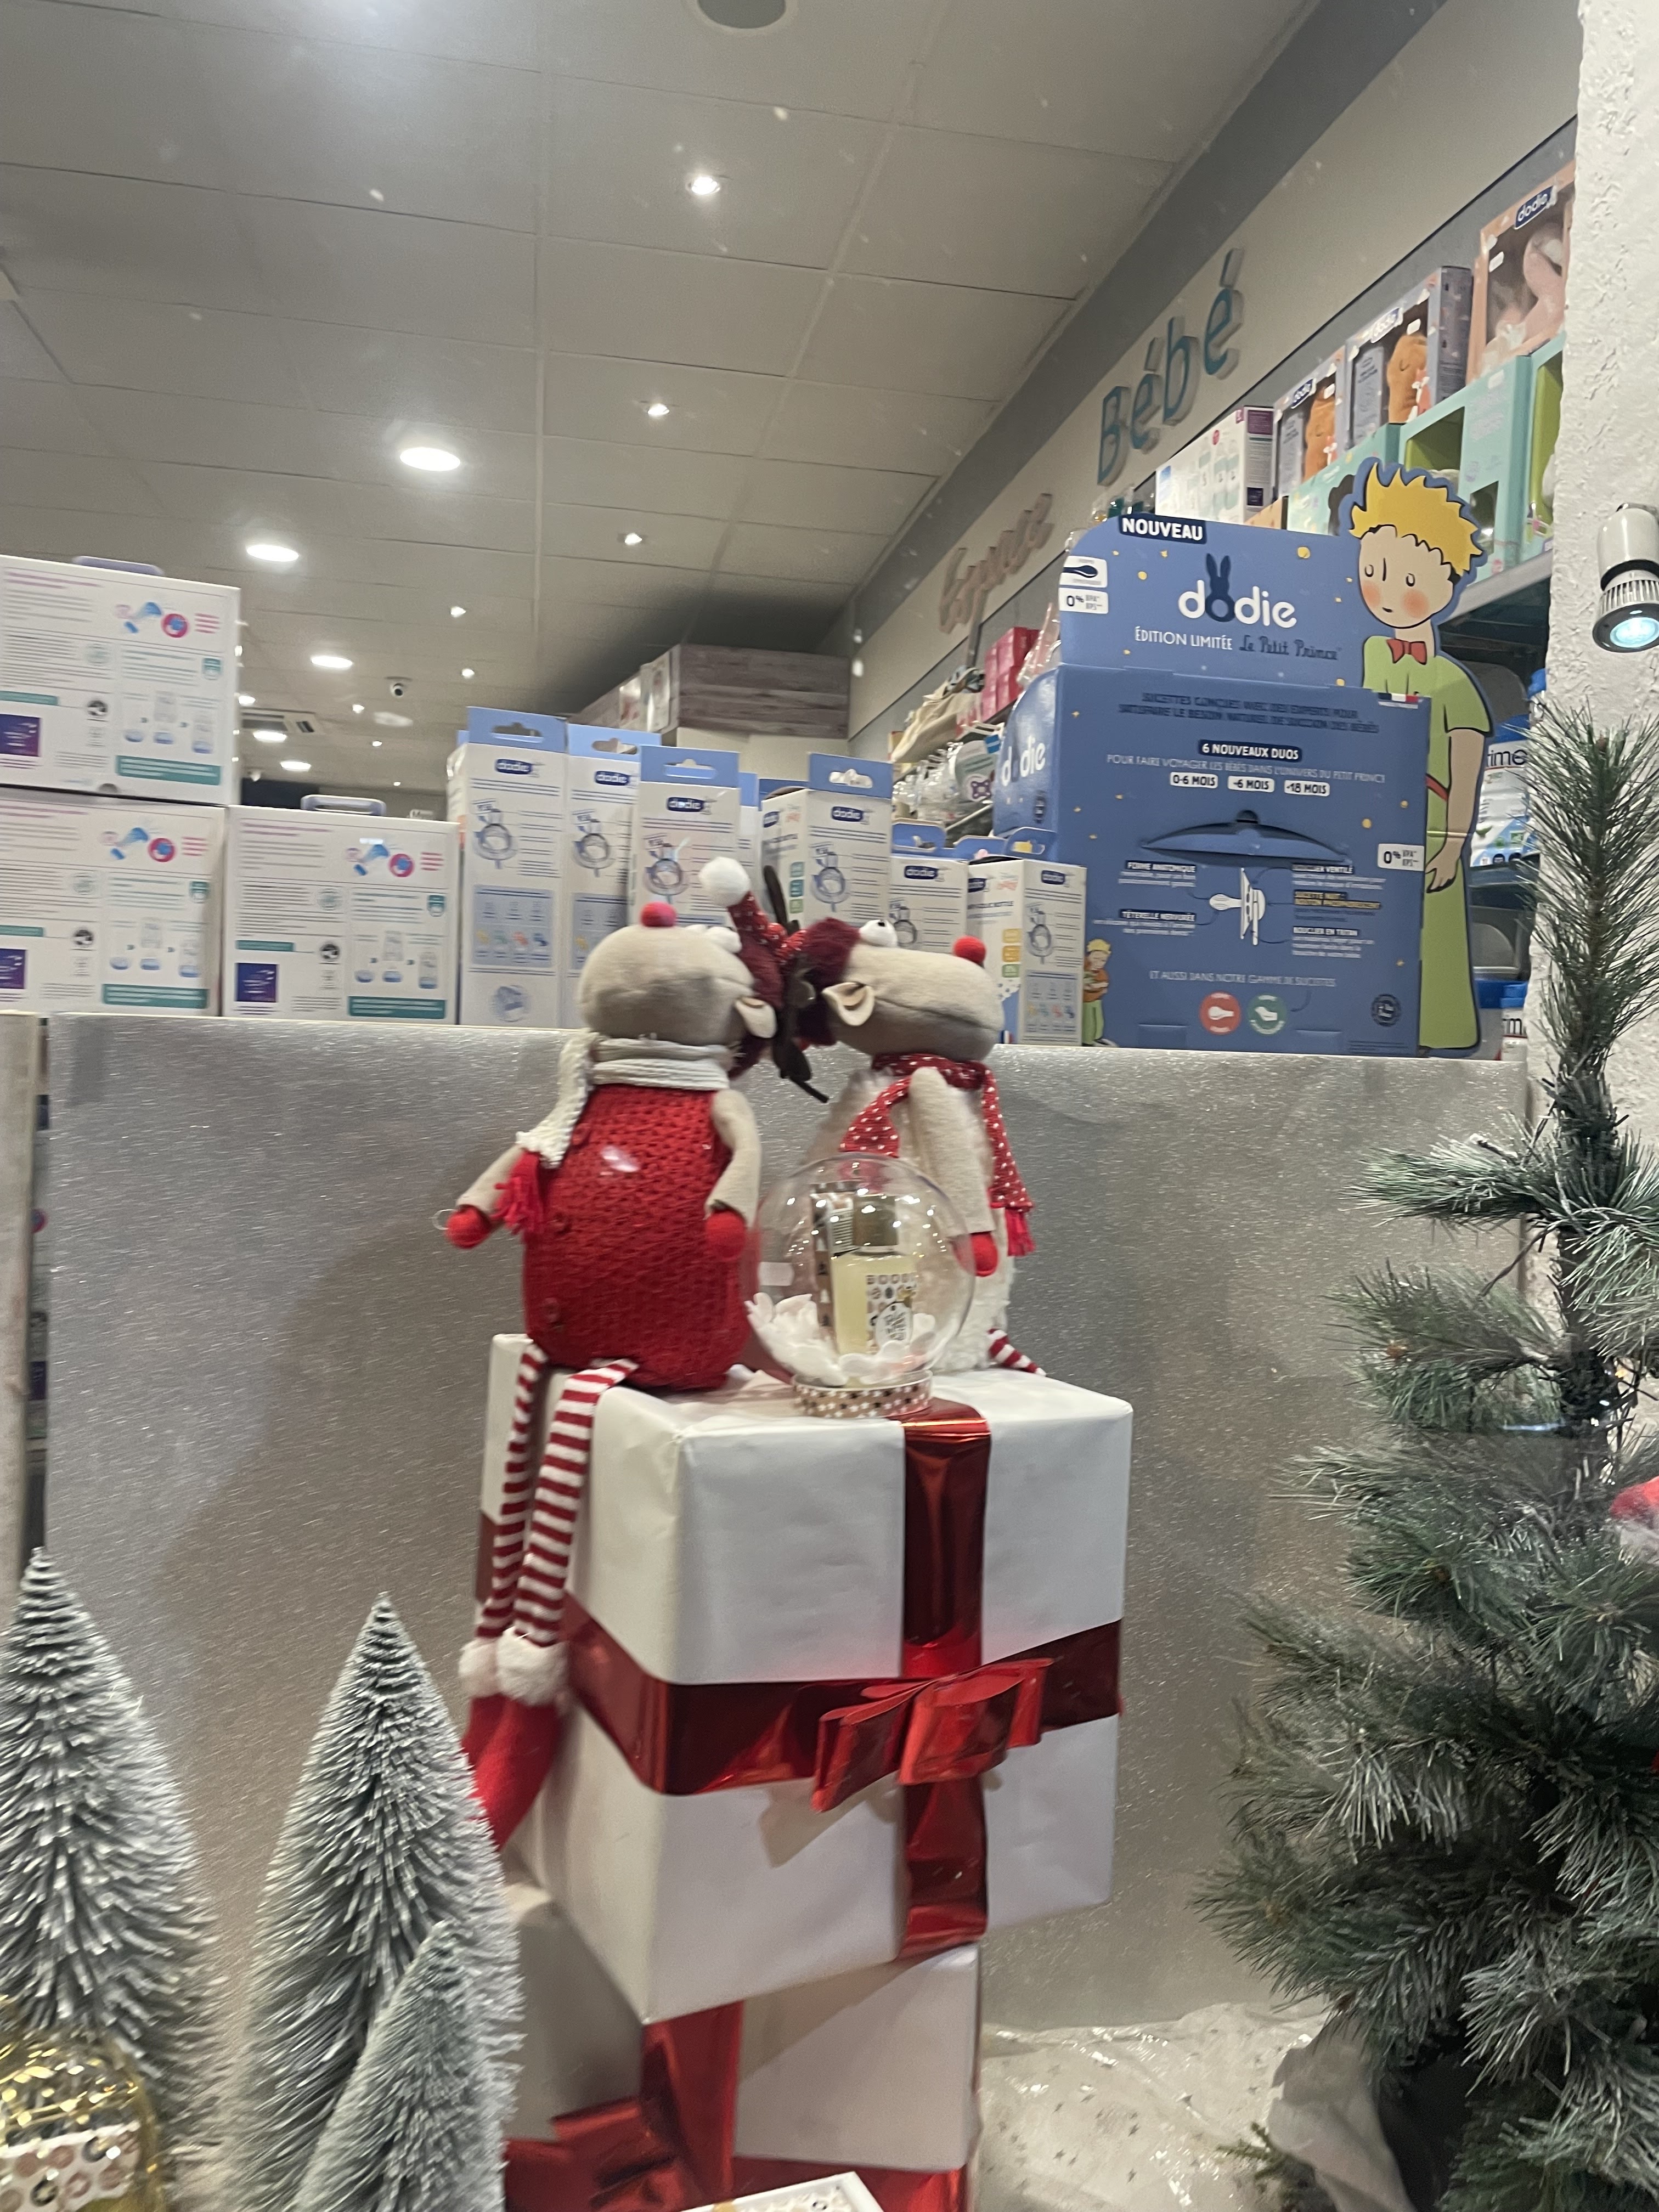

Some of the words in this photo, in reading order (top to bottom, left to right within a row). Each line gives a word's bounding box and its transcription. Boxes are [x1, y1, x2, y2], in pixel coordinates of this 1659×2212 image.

[1517, 193, 1548, 222] dodie
[1097, 248, 1244, 487] Bébé
[1122, 517, 1203, 541] NOUVEAU
[1178, 579, 1297, 629] dodie
[1135, 626, 1187, 645] ÉDITION
[1190, 635, 1233, 651] LIMITÉE
[1201, 743, 1210, 753] 6
[1212, 744, 1269, 758] NOUVEAUX
[1271, 748, 1299, 760] DUOS
[1173, 774, 1189, 785] 0-6
[1192, 776, 1215, 786] MOIS
[1246, 780, 1269, 790] MOIS
[1304, 784, 1327, 794] MOIS
[1384, 851, 1401, 864] 0%
